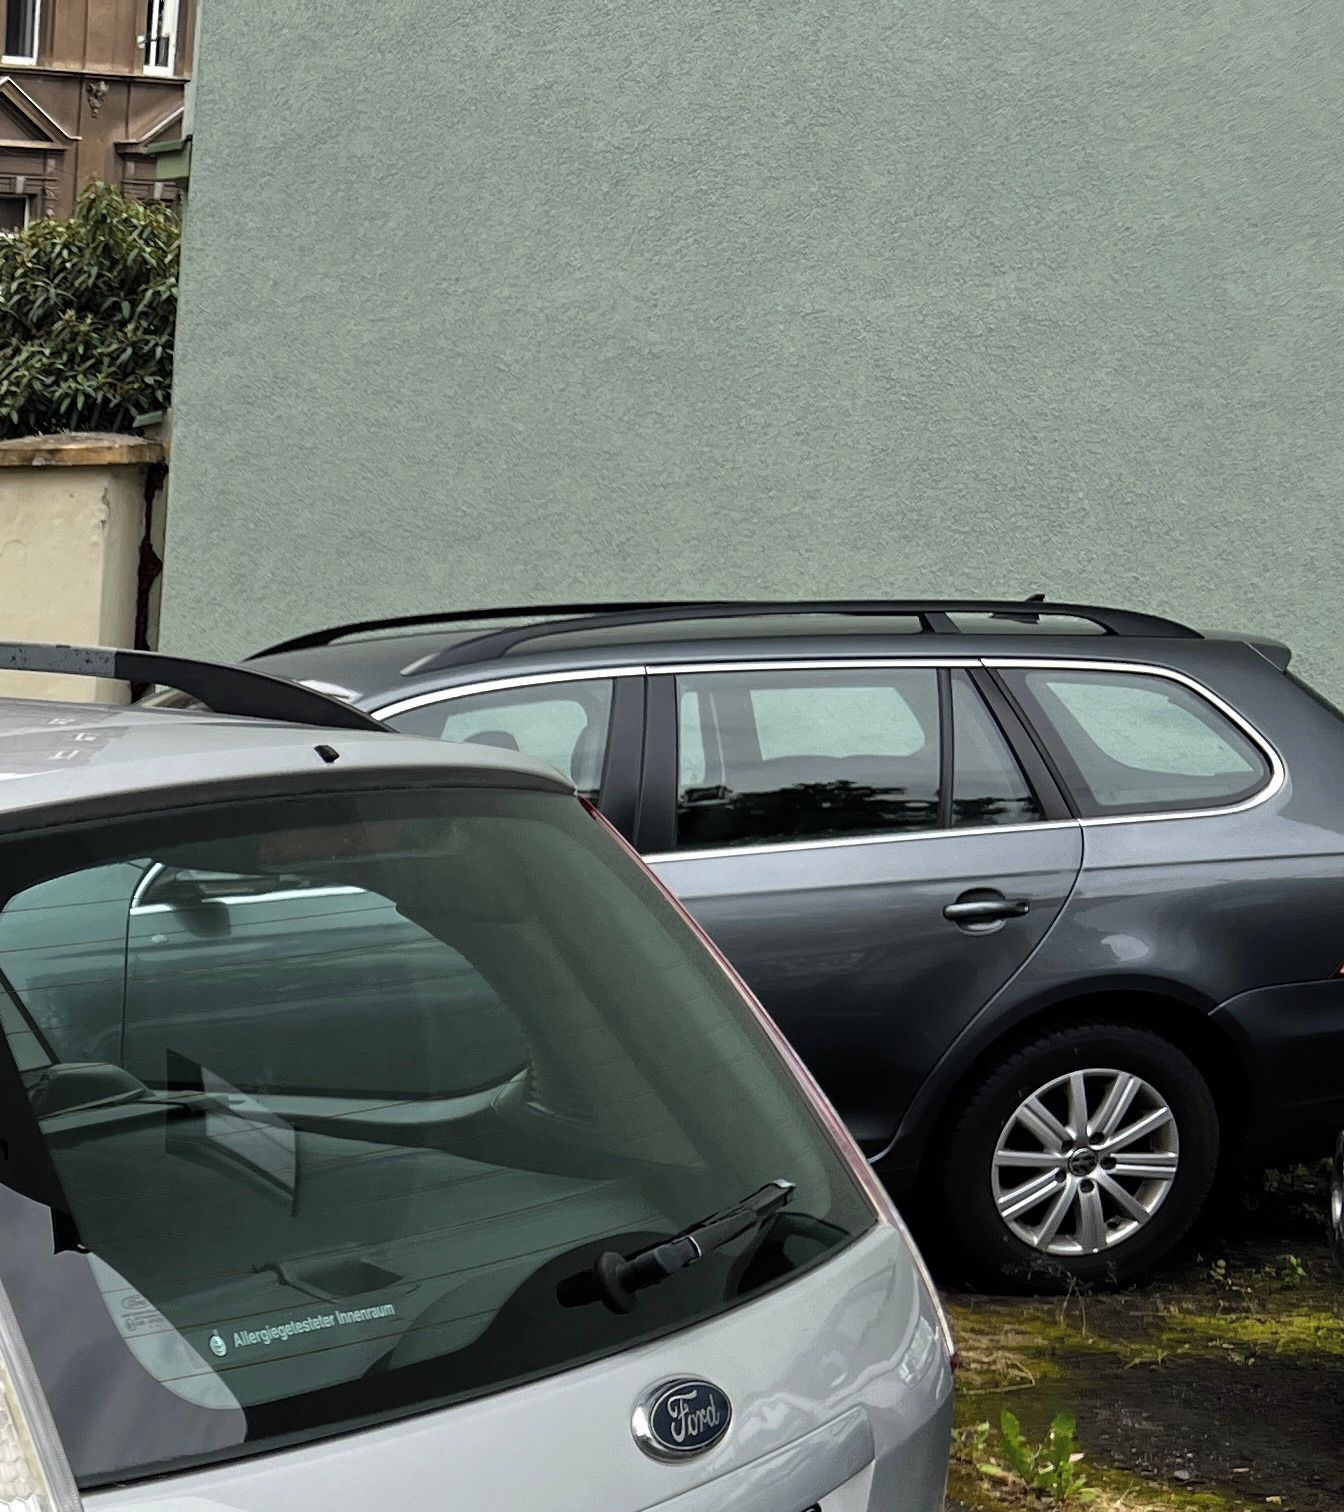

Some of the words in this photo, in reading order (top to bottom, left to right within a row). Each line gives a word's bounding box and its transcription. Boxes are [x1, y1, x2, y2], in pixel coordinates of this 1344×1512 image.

[233, 1312, 334, 1348] Allergiegetesteter
[336, 1304, 395, 1325] Innenraum
[669, 1389, 722, 1443] Ford
